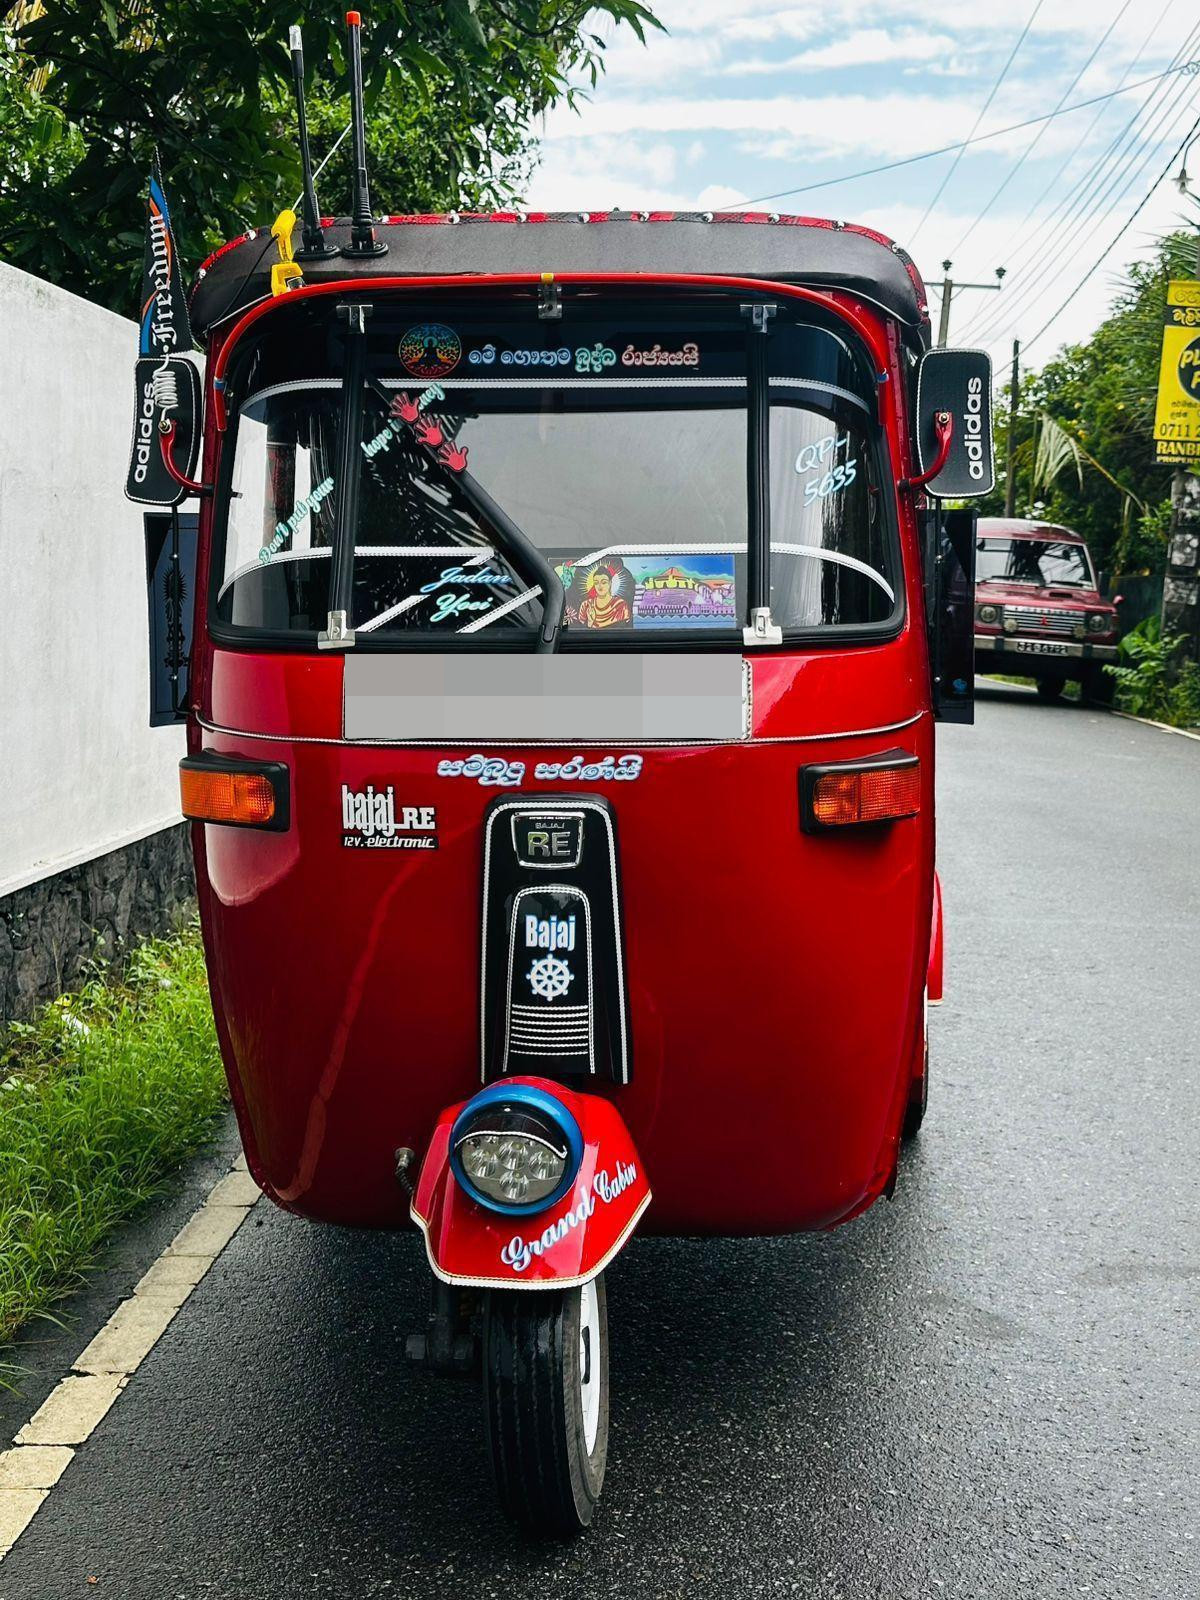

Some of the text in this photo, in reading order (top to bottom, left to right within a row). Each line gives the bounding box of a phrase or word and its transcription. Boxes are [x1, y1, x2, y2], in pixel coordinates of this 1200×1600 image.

[468, 343, 496, 365] මේ
[500, 347, 571, 367] ගෞතම
[133, 382, 154, 483] adidas
[361, 428, 394, 458] hope
[963, 376, 984, 480] adidas
[286, 500, 309, 535] put
[306, 476, 335, 514] your
[341, 784, 436, 837] bajaj RE
[528, 832, 571, 857] RE
[525, 915, 577, 951] Bajaj
[501, 1159, 638, 1272] Grand Cabin
